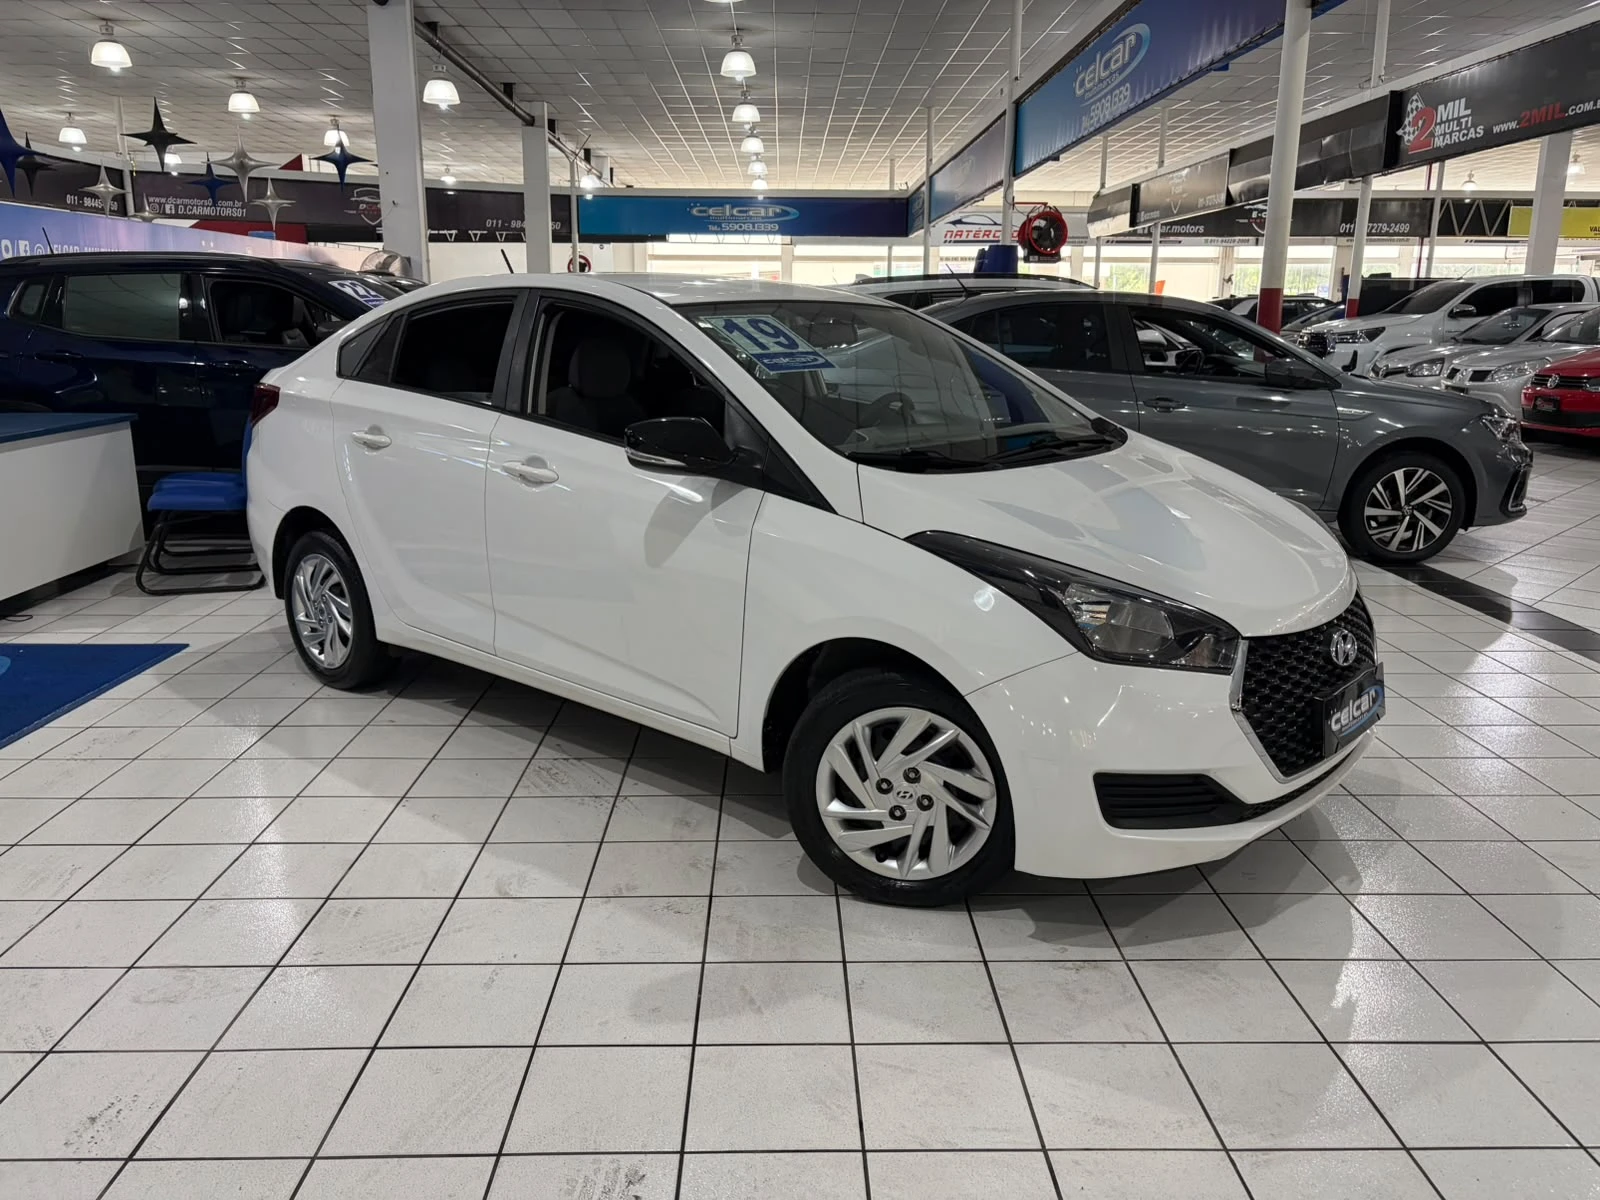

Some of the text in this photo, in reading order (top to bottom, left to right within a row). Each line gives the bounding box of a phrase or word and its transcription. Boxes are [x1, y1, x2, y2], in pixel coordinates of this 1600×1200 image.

[1074, 32, 1137, 98] celcar
[1408, 97, 1472, 154] 2 MIL
[1435, 117, 1472, 137] MULTI
[1434, 125, 1484, 148] MARCAS
[66, 194, 78, 205] 011
[148, 195, 243, 207] www.dcarmotors0.com.br
[178, 205, 247, 217] D.CARMOTORS01
[691, 203, 781, 217] celcar
[486, 219, 502, 228] 011
[1339, 223, 1355, 233] 011
[337, 282, 384, 299] 22
[722, 318, 799, 351] 19
[1330, 687, 1375, 732] celcar
